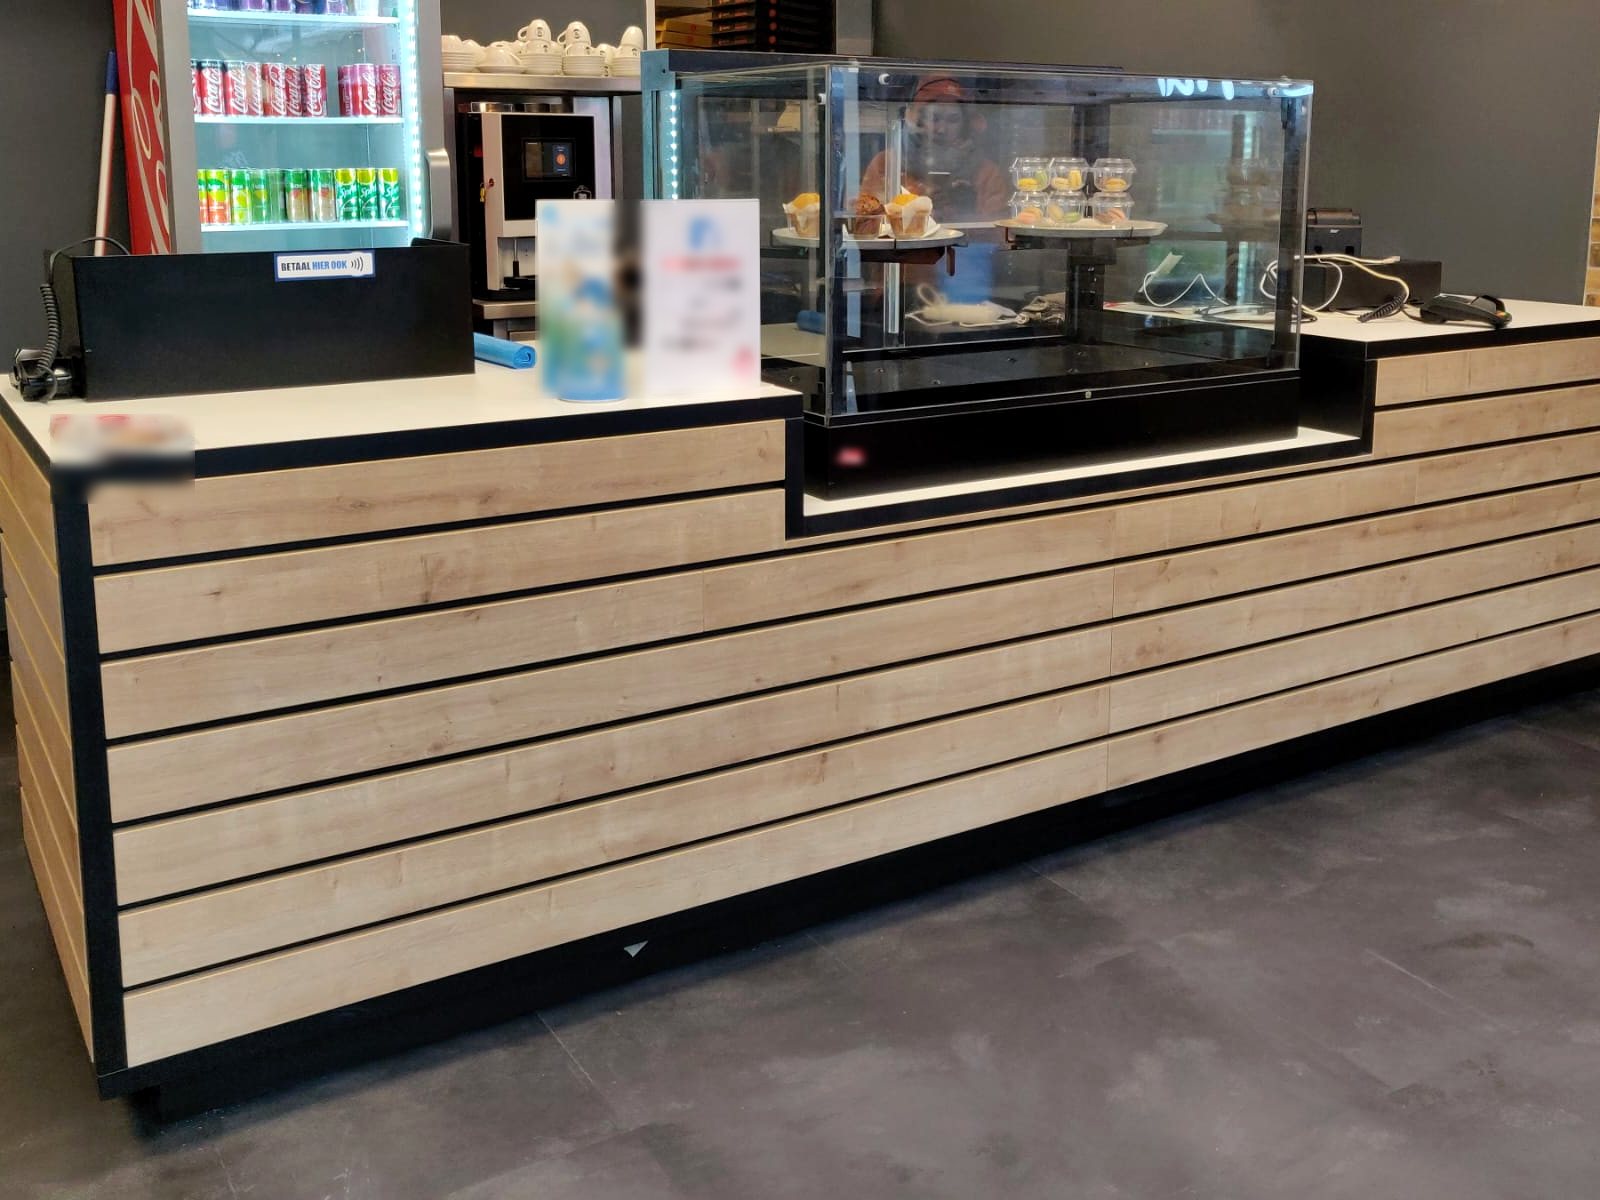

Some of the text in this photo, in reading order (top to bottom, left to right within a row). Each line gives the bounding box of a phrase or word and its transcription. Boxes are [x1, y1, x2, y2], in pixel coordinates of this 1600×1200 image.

[281, 260, 347, 271] BETAAL HIER OOK
